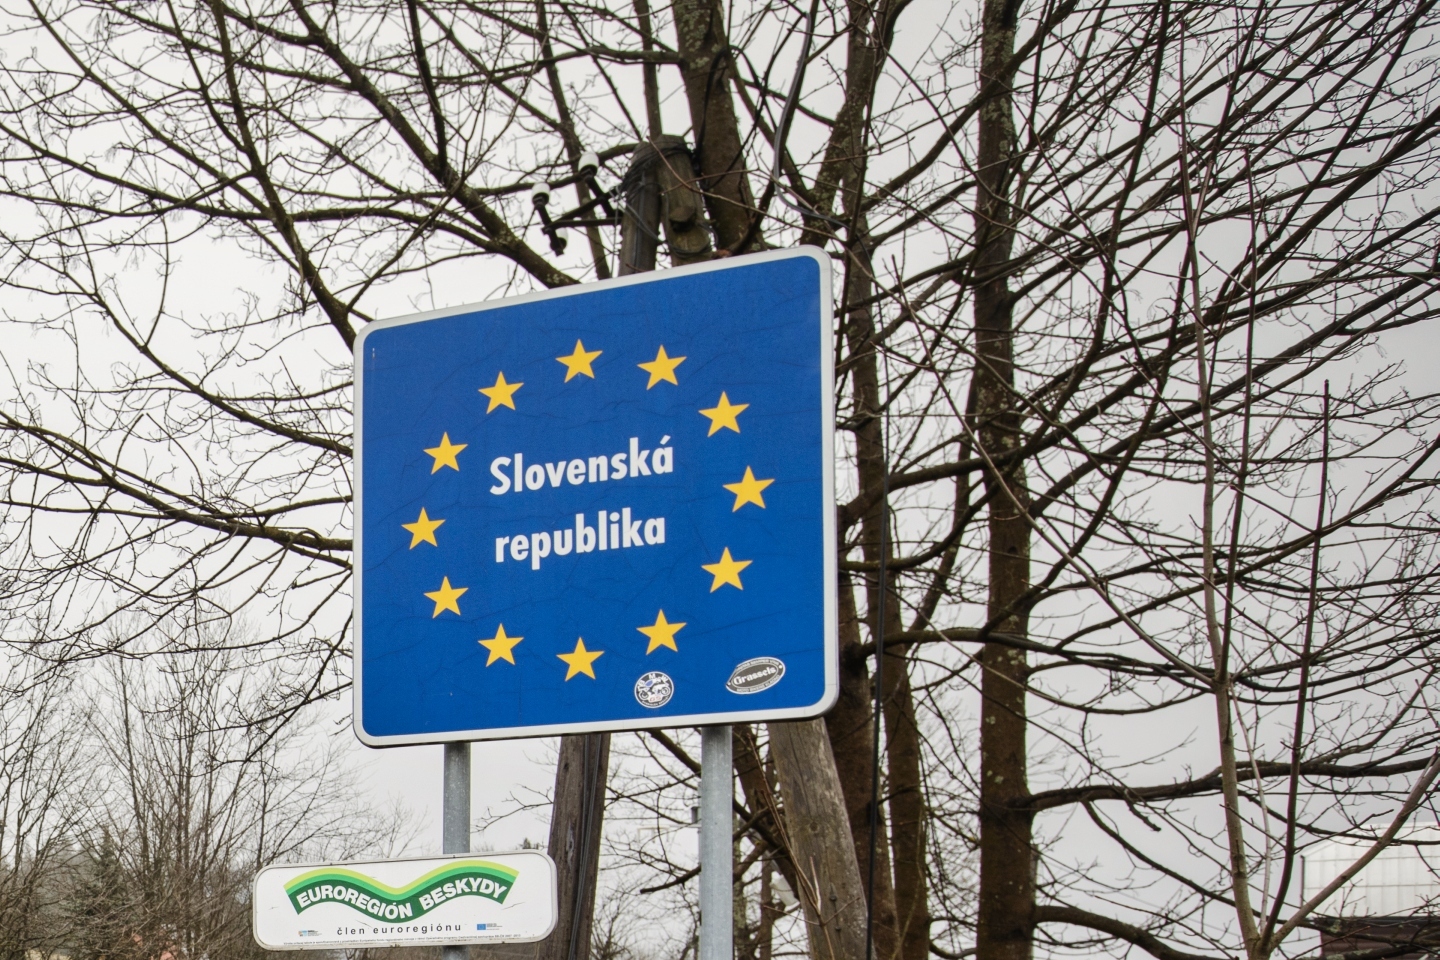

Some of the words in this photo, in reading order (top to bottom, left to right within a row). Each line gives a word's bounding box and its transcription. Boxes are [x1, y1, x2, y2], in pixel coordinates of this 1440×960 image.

[489, 434, 674, 496] Slovenská
[495, 507, 666, 571] republika
[296, 884, 413, 920] EUROREGIÓN
[418, 877, 508, 911] BESKYDY
[336, 926, 365, 936] člen
[372, 923, 461, 935] euroregiónu
